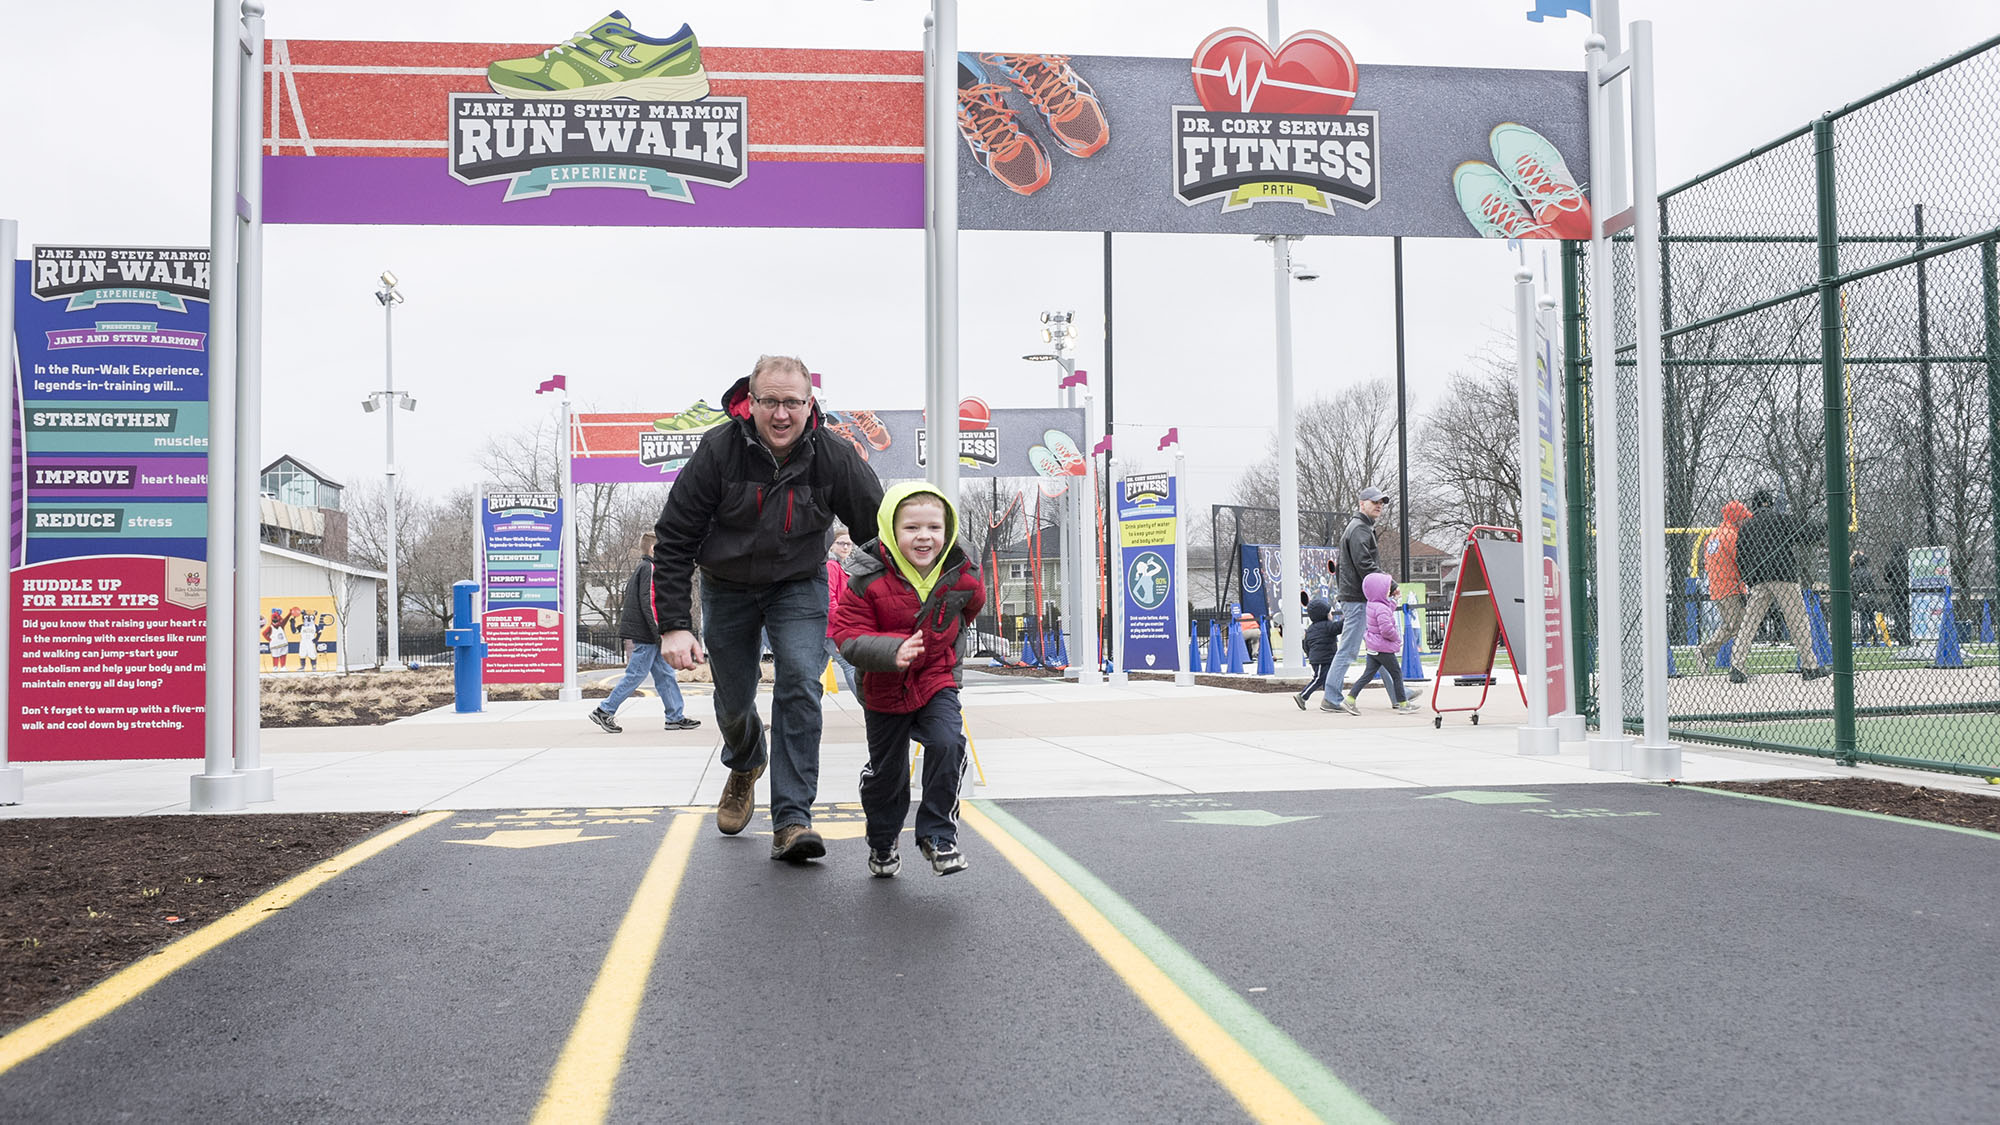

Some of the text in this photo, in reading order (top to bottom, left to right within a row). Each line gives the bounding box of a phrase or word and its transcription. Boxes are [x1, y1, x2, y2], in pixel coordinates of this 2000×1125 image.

[458, 102, 739, 120] JANE AND STEVE MARMON
[1183, 118, 1370, 136] DR. CORY SERVAAS
[459, 118, 738, 169] RUN-WALK
[1183, 137, 1371, 188] FITNESS
[551, 167, 648, 181] EXPERIENCE
[1263, 184, 1293, 195] PATH
[38, 250, 209, 260] JANE AND STEVE MARMO
[38, 260, 209, 289] RUN-WALK
[96, 290, 157, 300] EXPERIENCE
[54, 334, 200, 347] JANE AND STEVE MARMON
[35, 364, 45, 374] In
[49, 365, 69, 374] the
[72, 365, 129, 374] Run-Walk
[35, 380, 150, 393] legends-in-training
[34, 413, 170, 426] STRENGTHEN
[155, 435, 208, 446] muscles
[36, 471, 129, 483] IMPROVE
[142, 475, 173, 484] heart
[1127, 480, 1167, 497] FITNESS
[490, 499, 556, 510] RUN-WALK
[36, 514, 115, 527] REDUCE
[129, 516, 172, 527] stress
[23, 579, 121, 591] HUDDLE UP
[23, 594, 159, 606] FOR RILEY TIPS
[23, 620, 38, 628] Did
[40, 622, 58, 630] you
[88, 619, 109, 627] that
[112, 619, 144, 629] raising
[147, 621, 168, 629] your
[170, 619, 196, 627] heart
[53, 635, 92, 644] morning
[94, 634, 115, 642] with
[118, 634, 165, 642] exercises
[23, 650, 40, 658] and
[43, 650, 80, 659] walking
[101, 649, 154, 659] jump-start
[157, 651, 178, 659] your
[23, 665, 80, 673] metabolism
[83, 664, 100, 672] and
[103, 664, 123, 674] help
[125, 666, 147, 674] your
[149, 664, 172, 673] body
[22, 679, 163, 689] maintain energy all day long?
[22, 706, 48, 714] Don't
[51, 706, 82, 716] forget
[127, 707, 138, 715] up
[141, 705, 162, 713] with
[22, 721, 44, 729] walk
[47, 721, 65, 729] and
[67, 721, 87, 729] cool
[117, 721, 128, 730] by
[131, 720, 184, 729] stretching.
